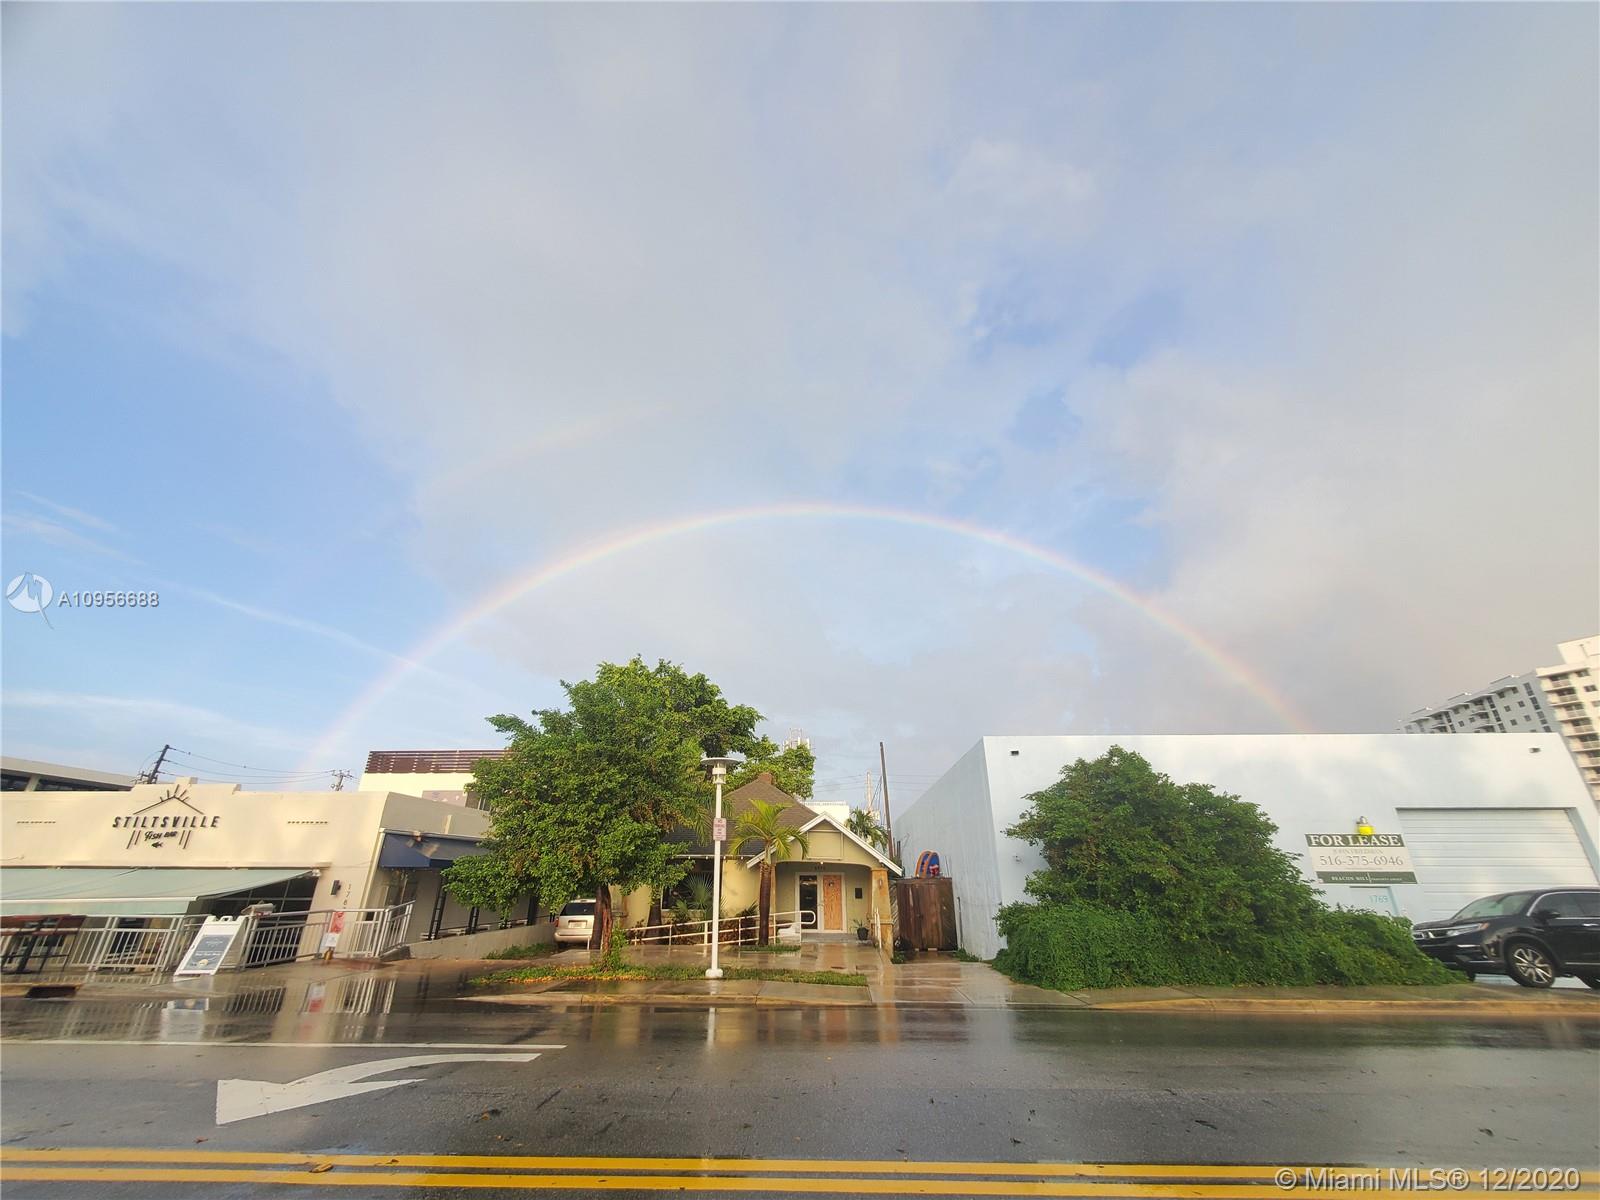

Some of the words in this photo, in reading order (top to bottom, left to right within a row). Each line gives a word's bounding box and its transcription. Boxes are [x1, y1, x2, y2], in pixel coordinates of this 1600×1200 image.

[112, 815, 221, 828] STILTSVILLE
[1309, 834, 1345, 846] FOR
[1346, 834, 1402, 846] LEASE
[1319, 855, 1405, 866] 516-375-6946
